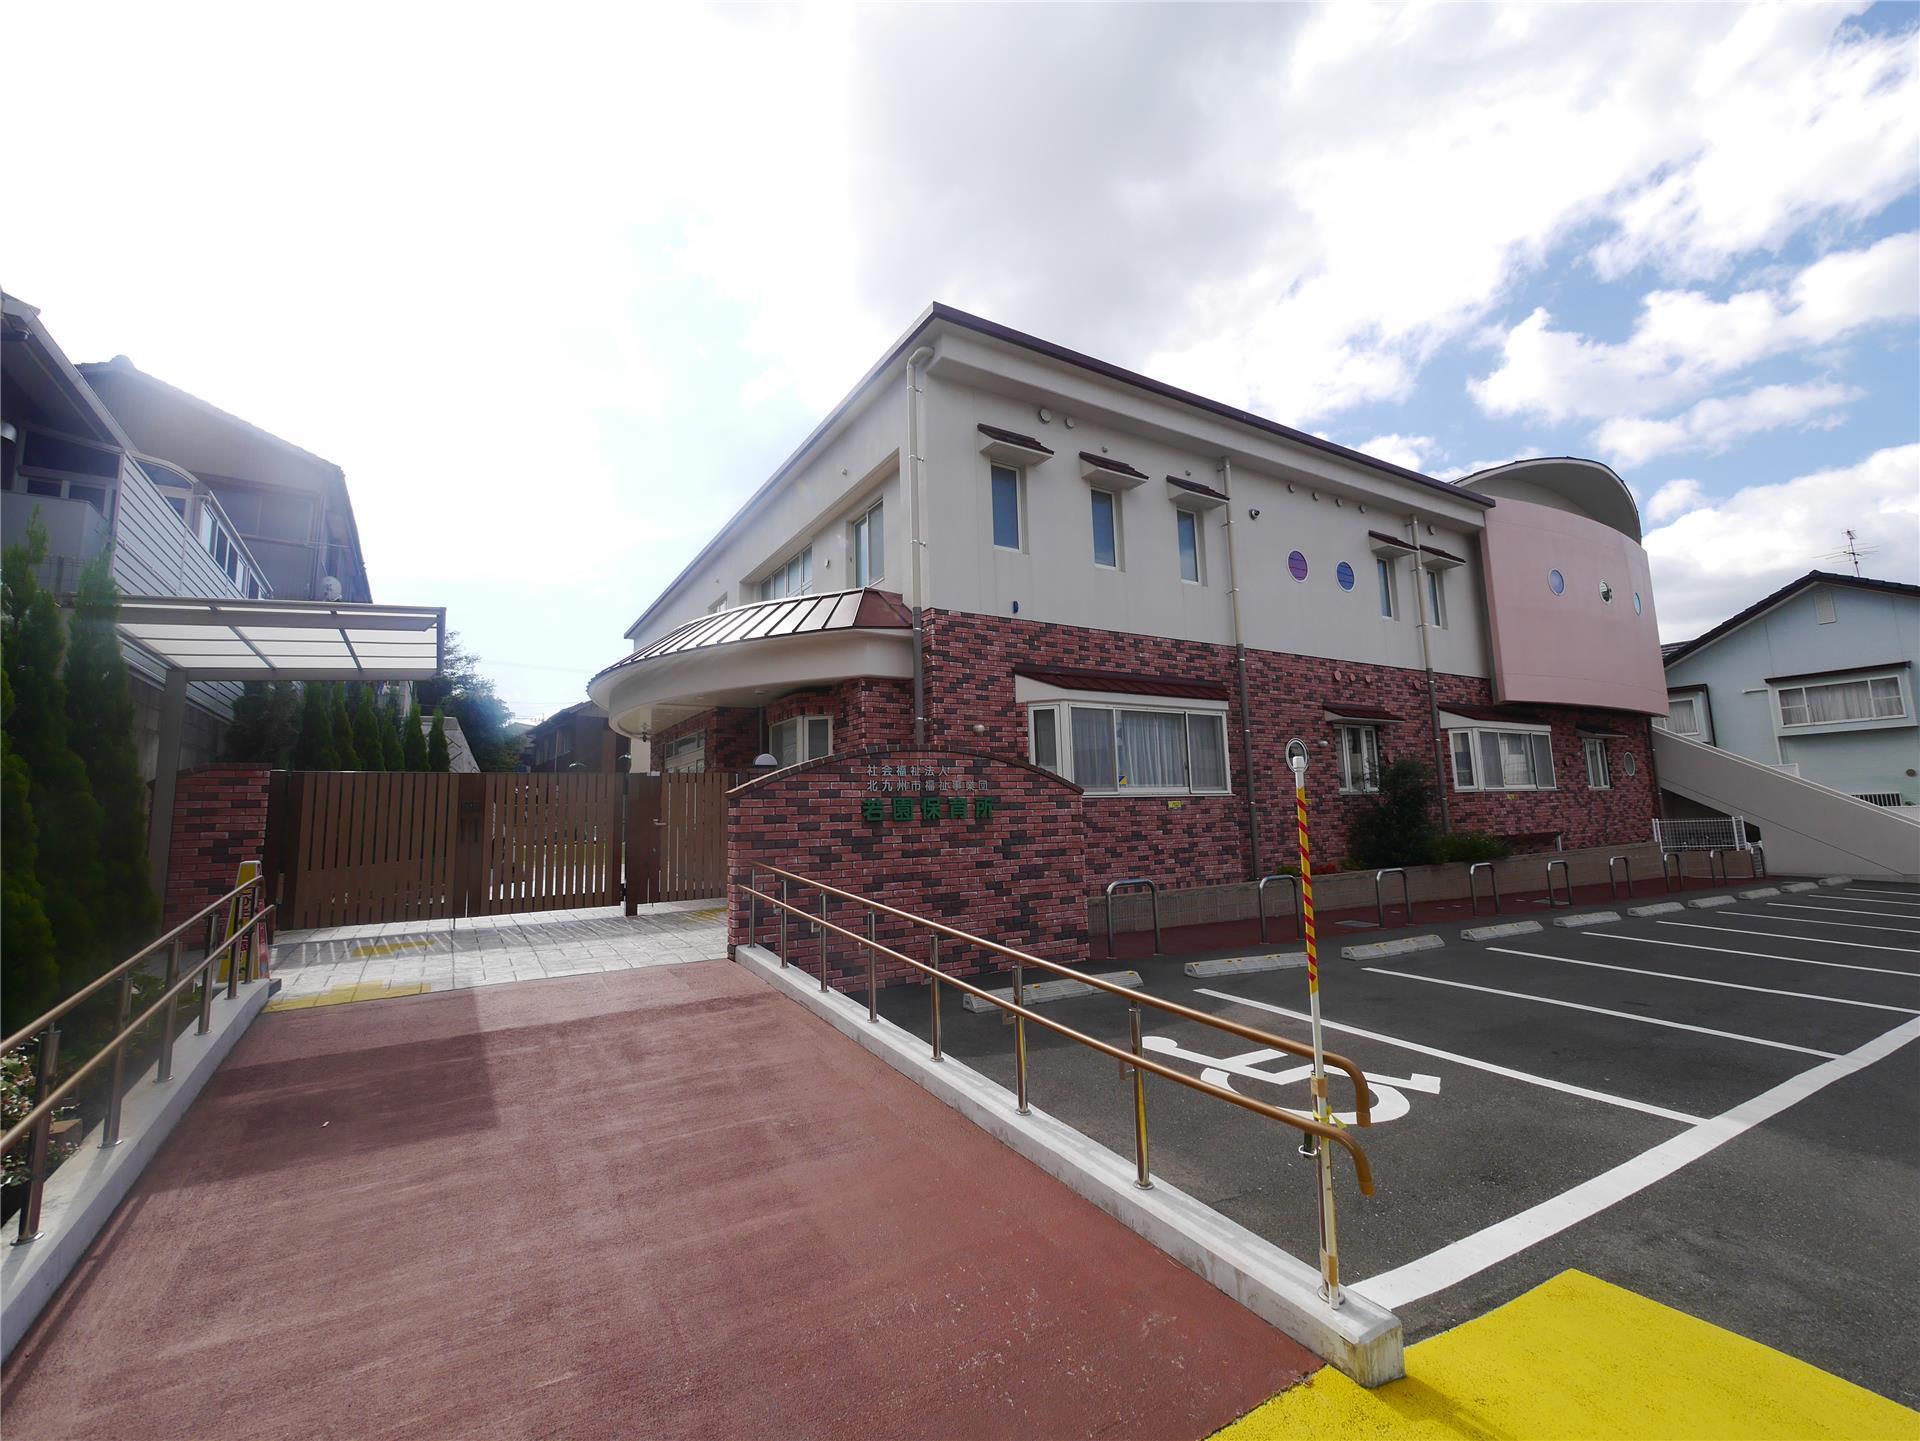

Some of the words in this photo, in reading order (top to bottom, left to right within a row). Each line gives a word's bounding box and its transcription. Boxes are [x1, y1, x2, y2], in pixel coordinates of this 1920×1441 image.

[867, 765, 949, 777] 社会福祉法人
[867, 779, 989, 792] 北九州市福祉事業団
[863, 797, 993, 822] 若園保育所
